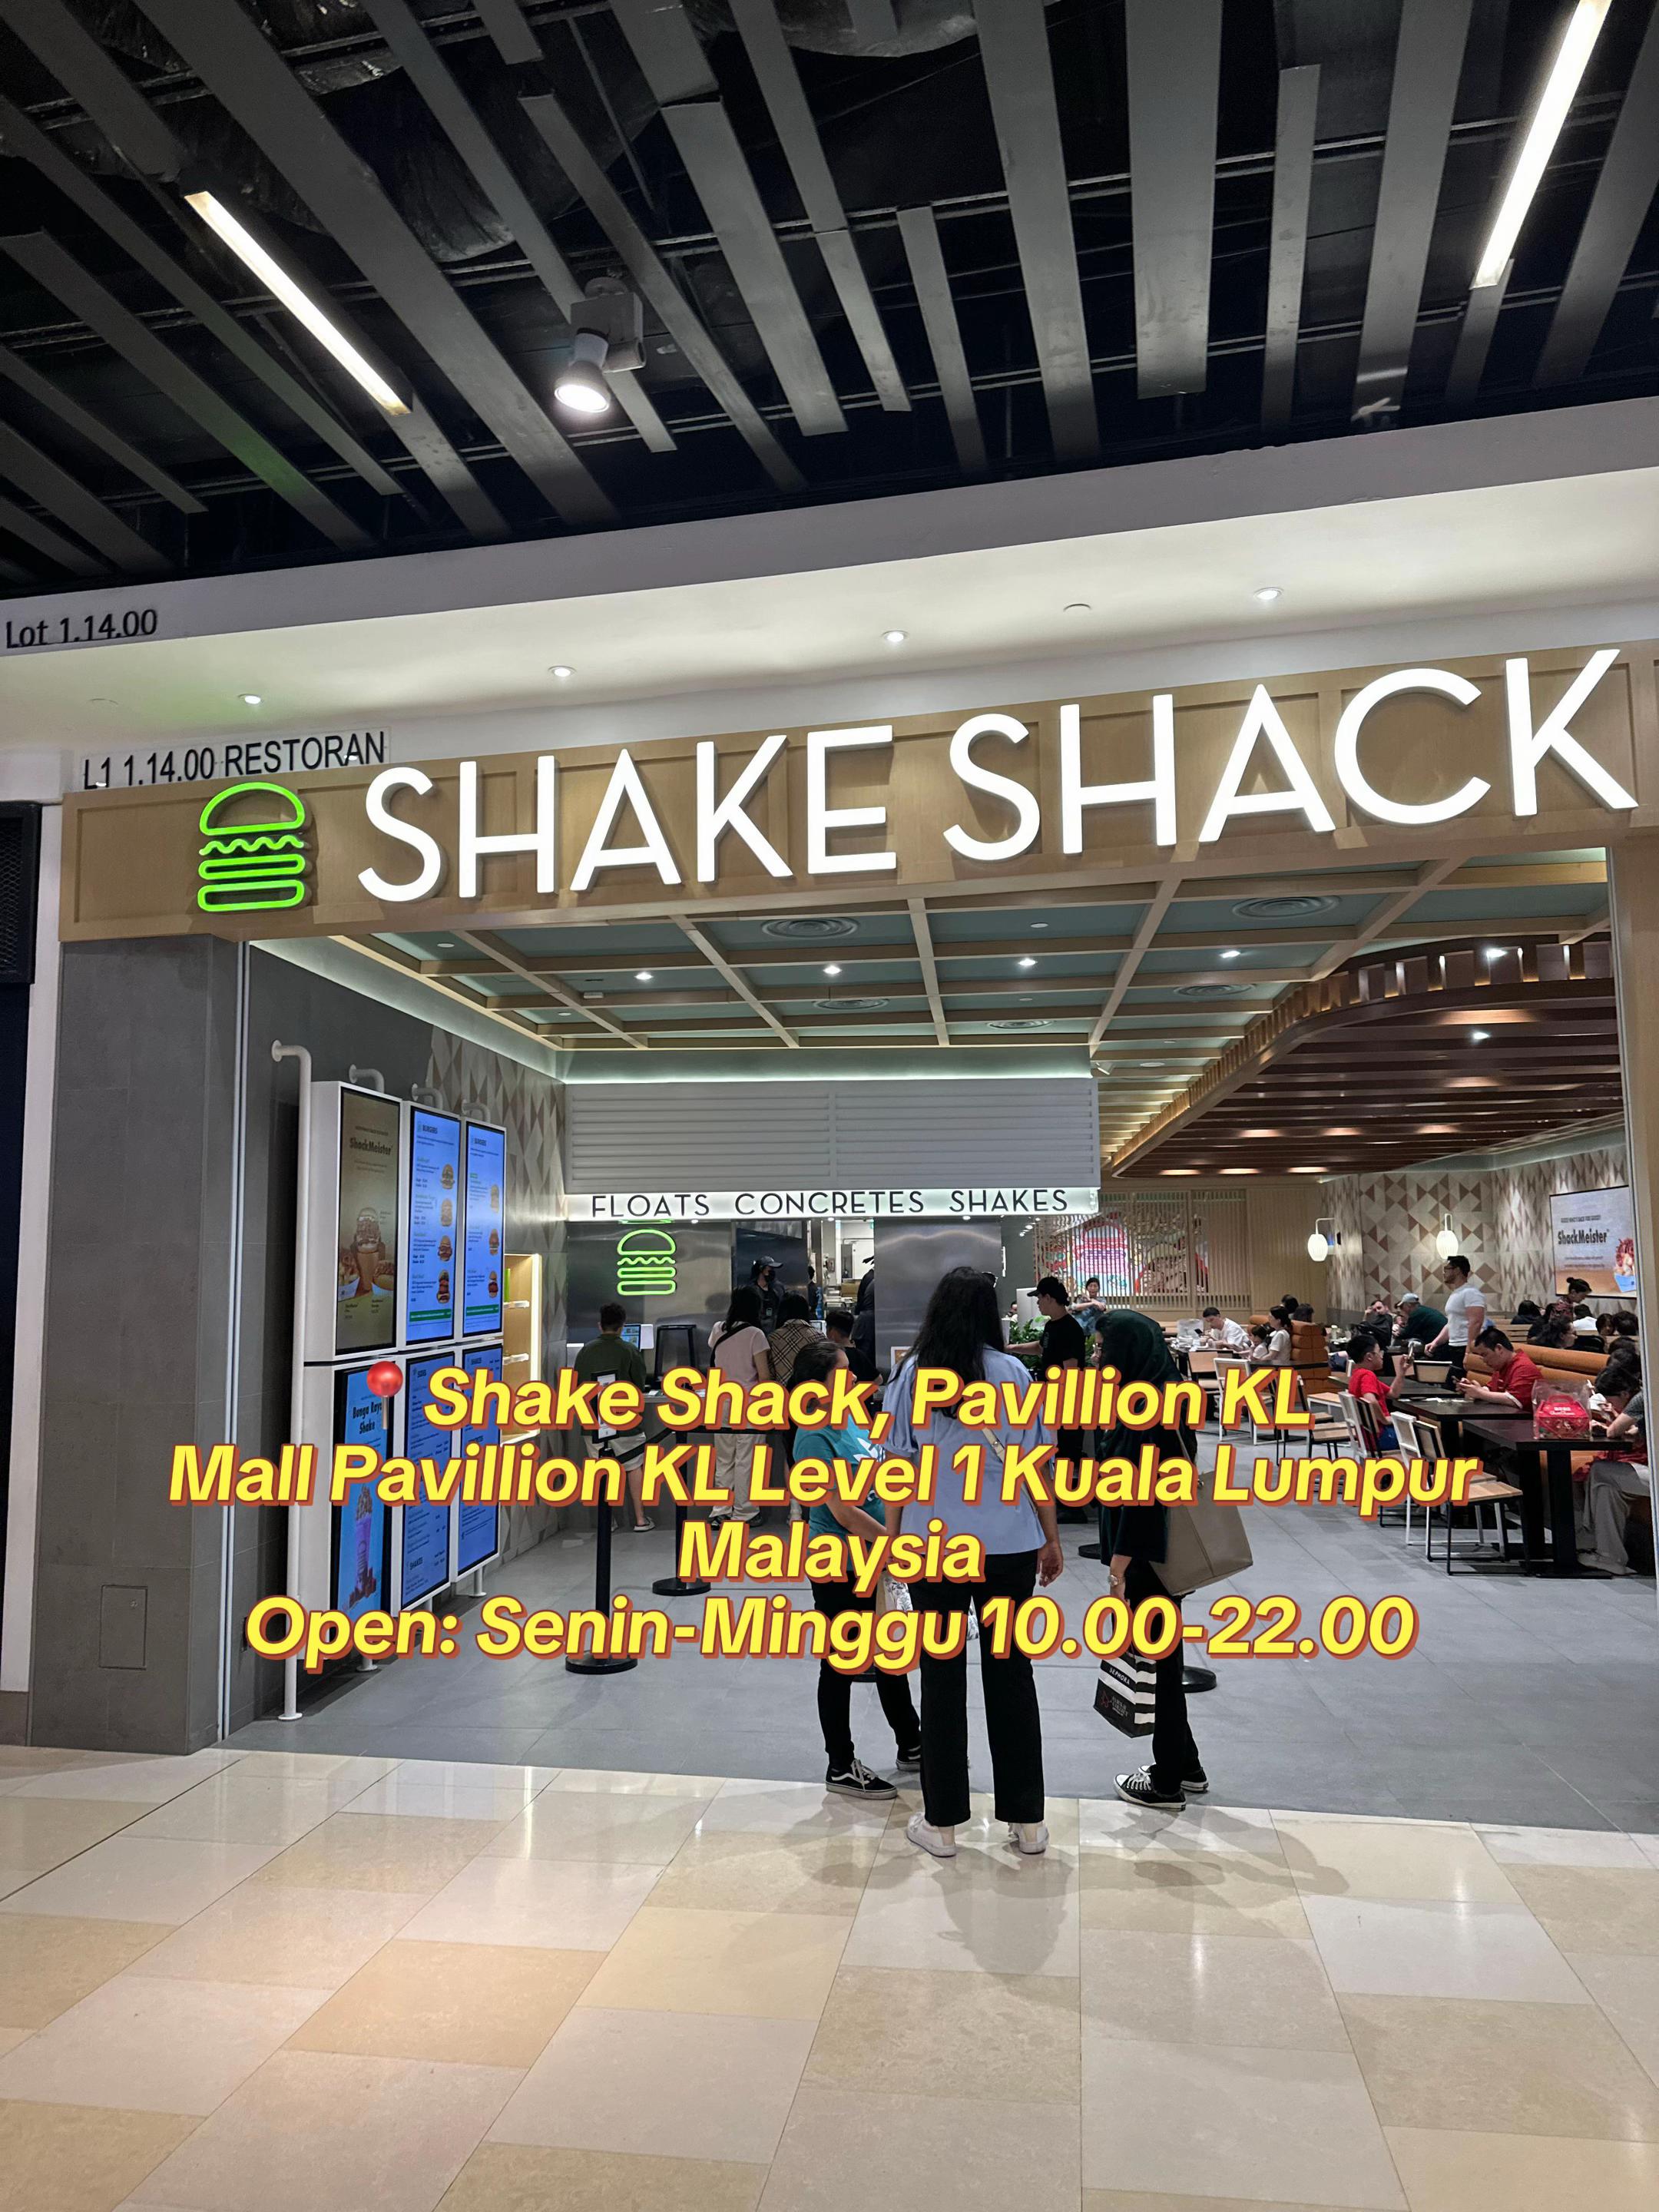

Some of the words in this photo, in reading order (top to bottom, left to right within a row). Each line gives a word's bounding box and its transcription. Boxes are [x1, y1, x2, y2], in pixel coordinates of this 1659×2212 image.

[5, 619, 48, 649] Lot
[59, 608, 158, 644] 1.14.00
[84, 756, 111, 790] L1
[123, 746, 216, 787] 1.14.00
[224, 730, 386, 778] RESTORAN
[357, 724, 899, 903] SHAKE
[942, 648, 1639, 861] SHACK
[591, 1194, 710, 1218] FLOATS
[734, 1190, 925, 1216] CONCRETES
[948, 1188, 1068, 1213] SHAKES
[1558, 1227, 1608, 1245] ShackMeister
[1108, 1667, 1131, 1686] SEPHORA
